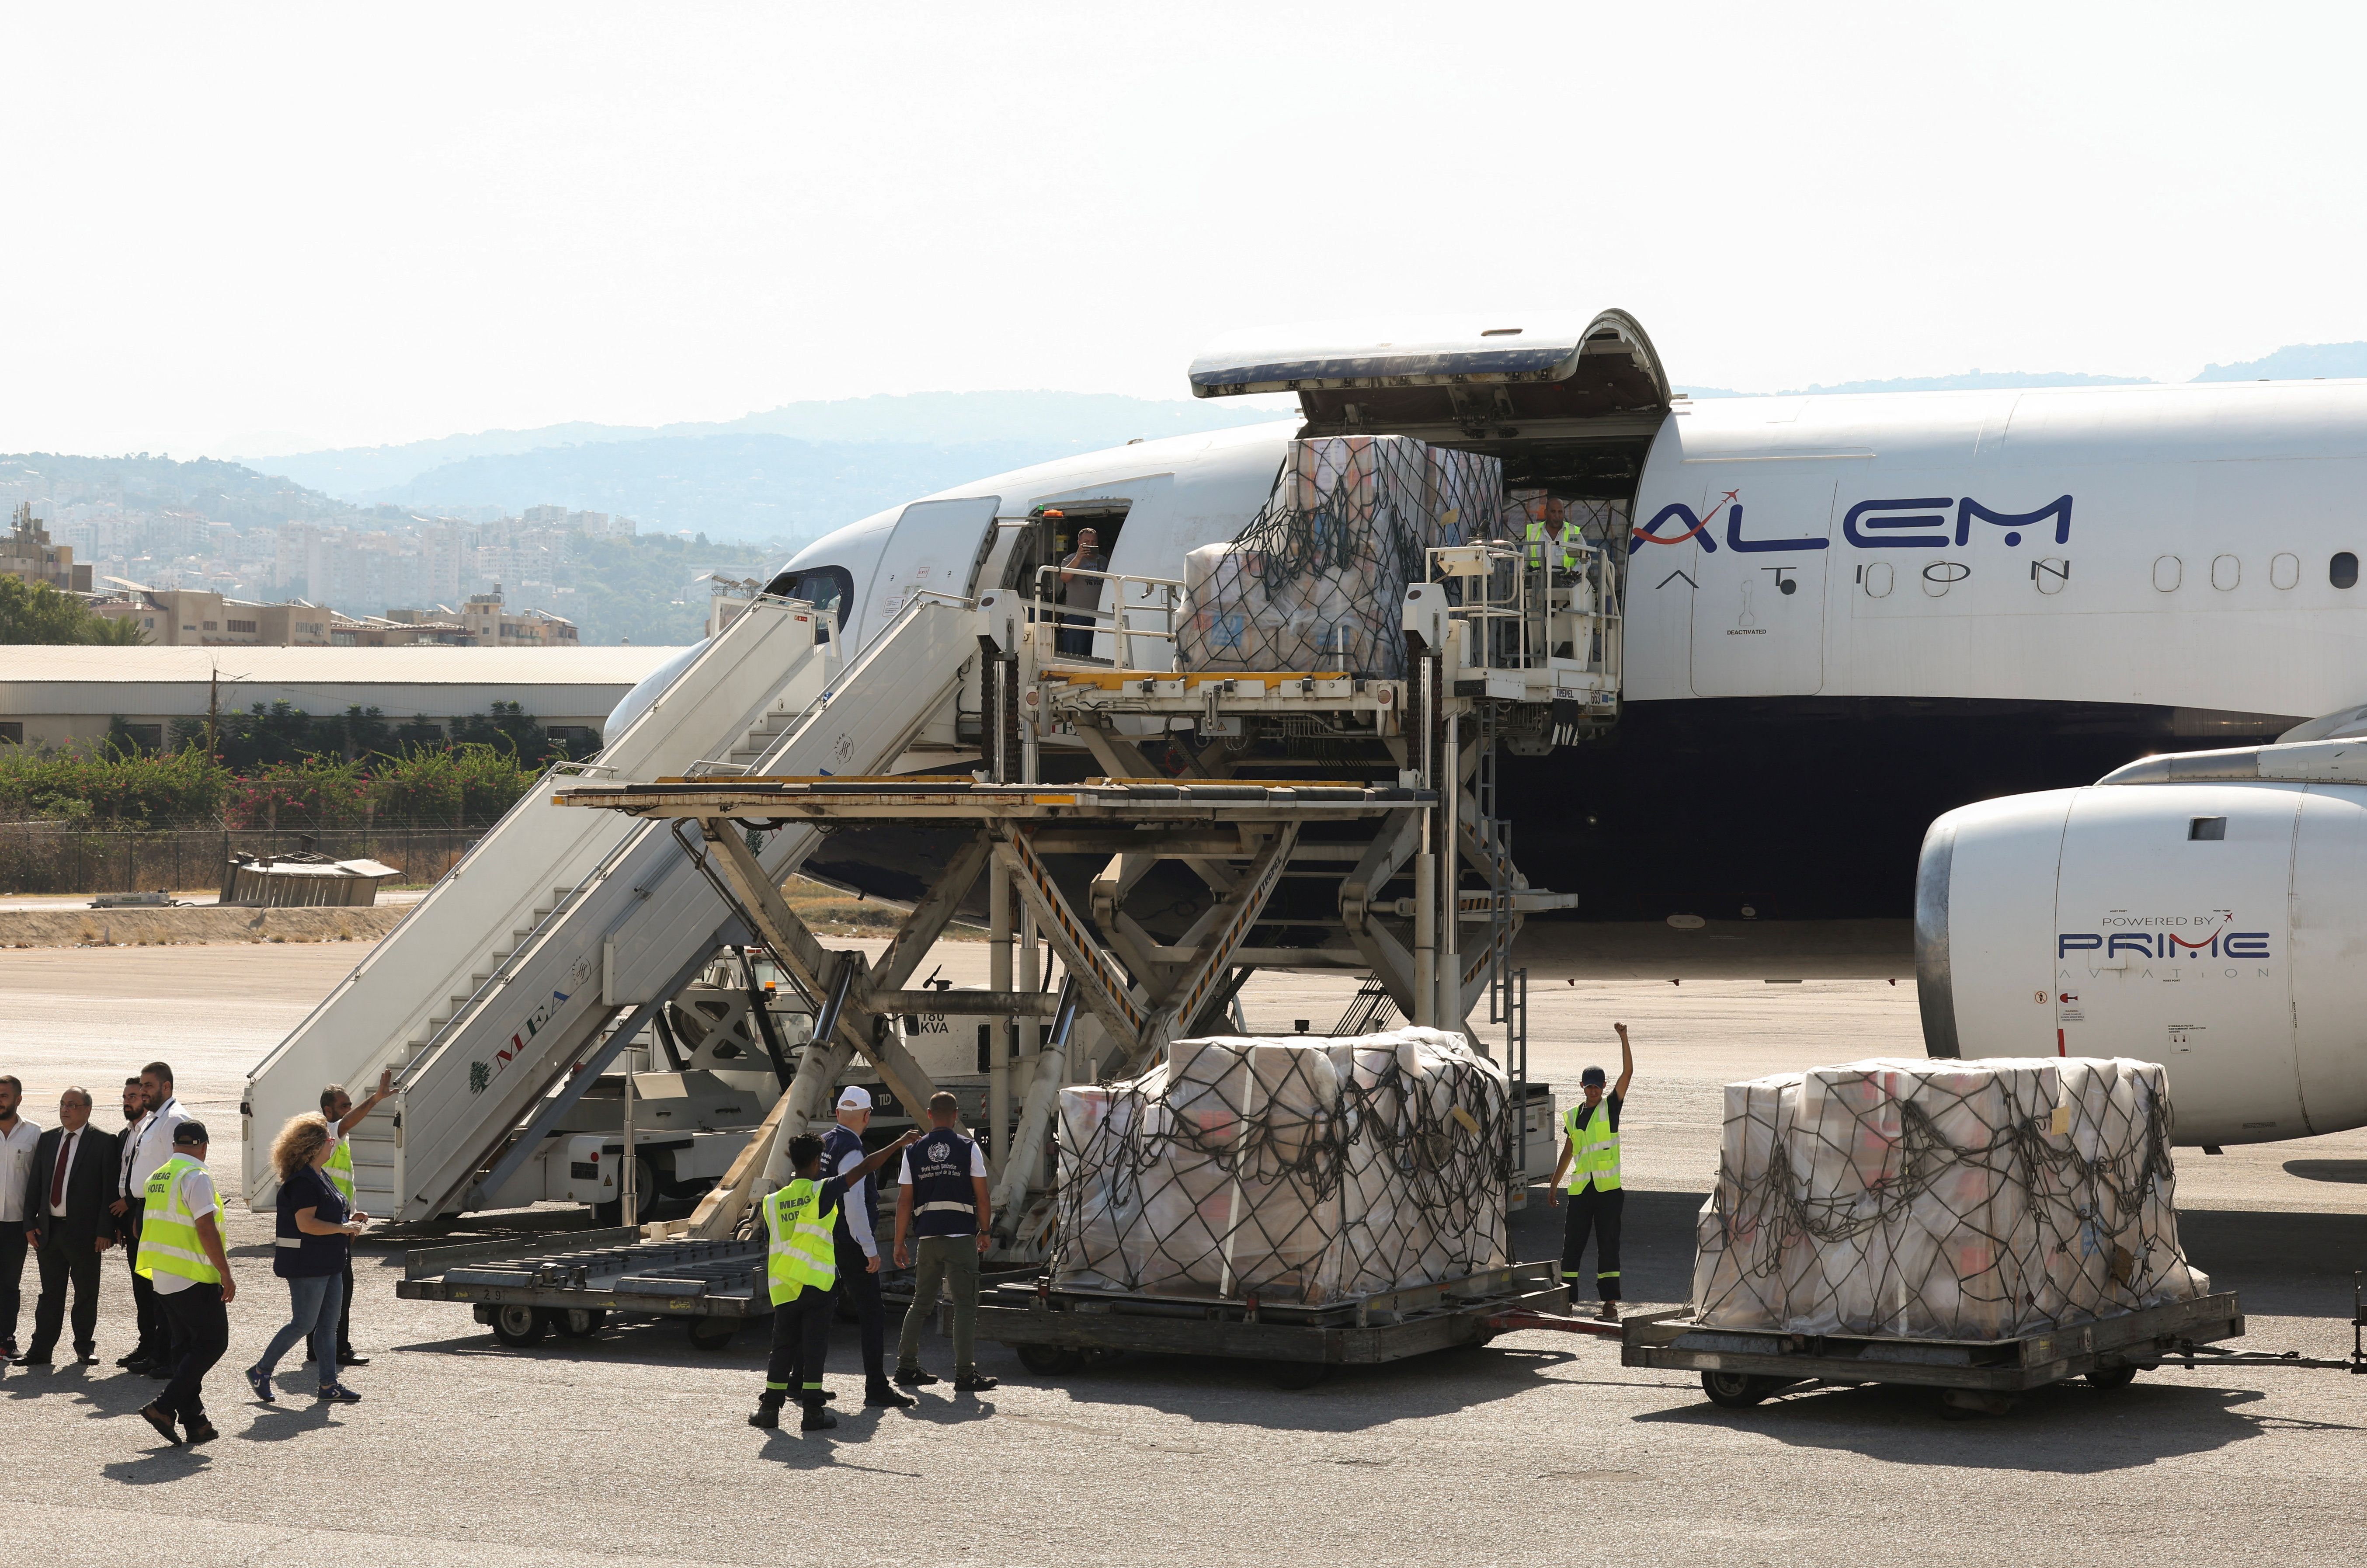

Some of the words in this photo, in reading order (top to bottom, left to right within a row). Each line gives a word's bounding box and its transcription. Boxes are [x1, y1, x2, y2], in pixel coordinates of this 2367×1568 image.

[1556, 688, 1574, 699] TREPEL
[1591, 691, 1601, 705] 663
[1261, 855, 1282, 891] TREPEL
[2103, 917, 2187, 926] POWERED
[2194, 917, 2214, 925] BY
[2058, 932, 2270, 959] PRIME
[2059, 968, 2269, 978] AVIATION
[492, 991, 572, 1071] MEA
[920, 1022, 949, 1033] KVA
[878, 1094, 892, 1106] TLD
[152, 1172, 171, 1180] MEAG
[779, 1195, 811, 1210] MEAG
